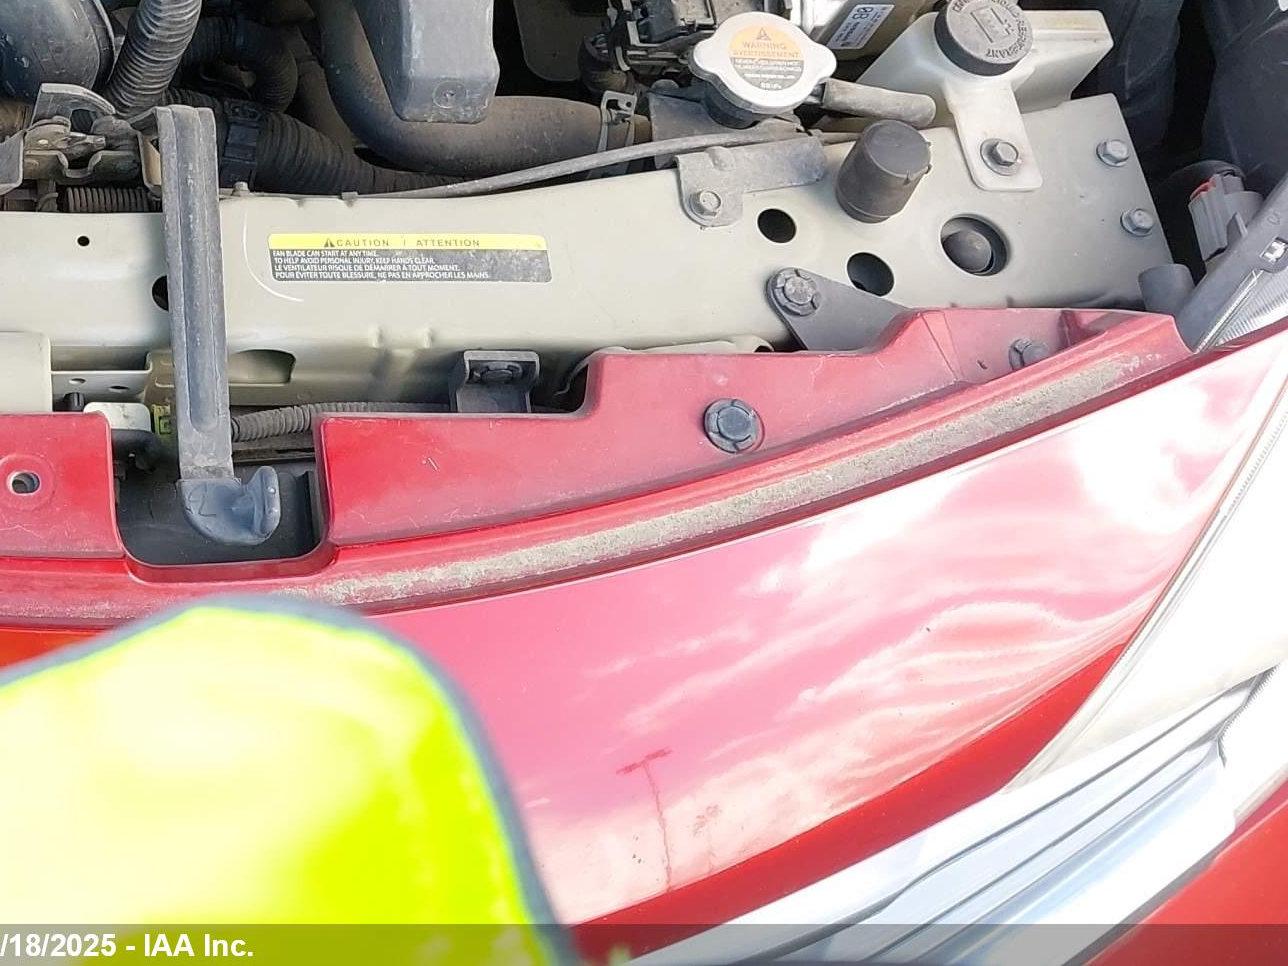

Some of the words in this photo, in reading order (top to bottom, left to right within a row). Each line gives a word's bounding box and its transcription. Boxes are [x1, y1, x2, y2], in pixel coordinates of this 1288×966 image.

[742, 41, 787, 50] WARNING
[336, 239, 389, 247] CAUTION
[416, 239, 480, 247] ATTENTION
[276, 271, 295, 279] POUR
[319, 271, 341, 279] TOUTE
[388, 271, 401, 279] PAS
[412, 271, 453, 279] APPROCHER
[454, 271, 465, 279] LES
